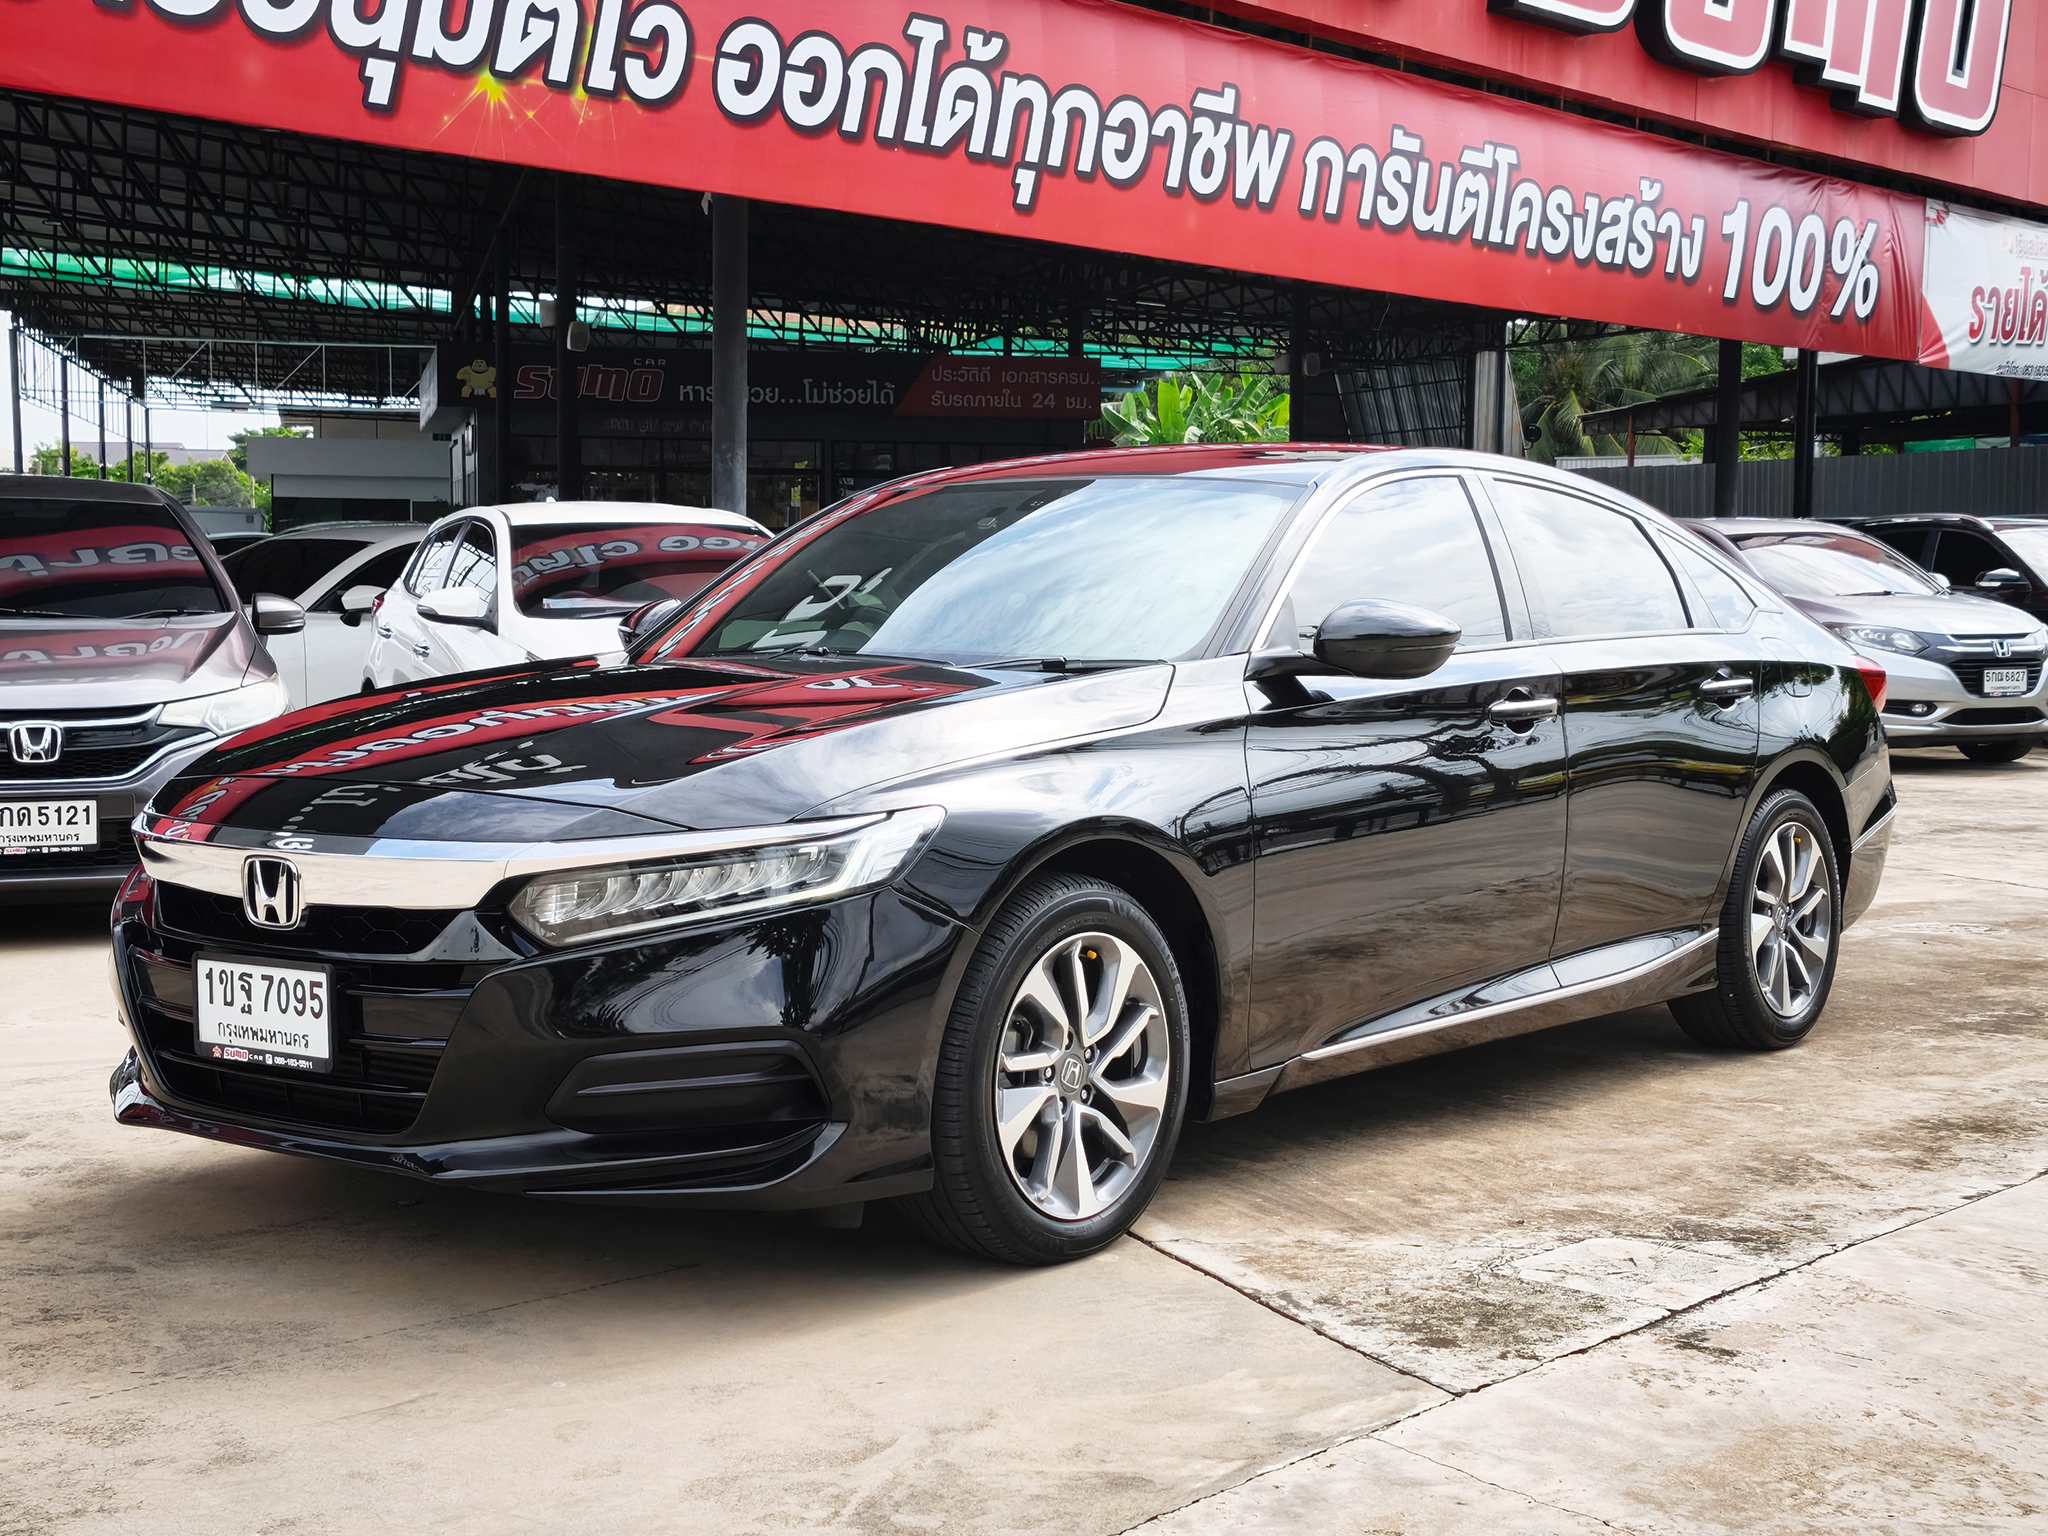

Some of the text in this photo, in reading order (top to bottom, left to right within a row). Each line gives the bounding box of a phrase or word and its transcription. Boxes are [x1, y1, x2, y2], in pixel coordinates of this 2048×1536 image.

[716, 18, 1291, 206] ออกได้ทุกอาชีพ
[1299, 129, 1705, 278] การันตีโครงสร้าง
[1721, 200, 1879, 319] 100%
[634, 358, 667, 367] CAR
[1032, 392, 1056, 409] 24
[1065, 396, 1093, 409] ชม.
[2005, 671, 2026, 682] 6827
[37, 805, 90, 826] 5121
[260, 974, 324, 1020] 7095
[217, 1022, 309, 1049] กรุงเทพมหานคร
[224, 1048, 248, 1060] SUMO
